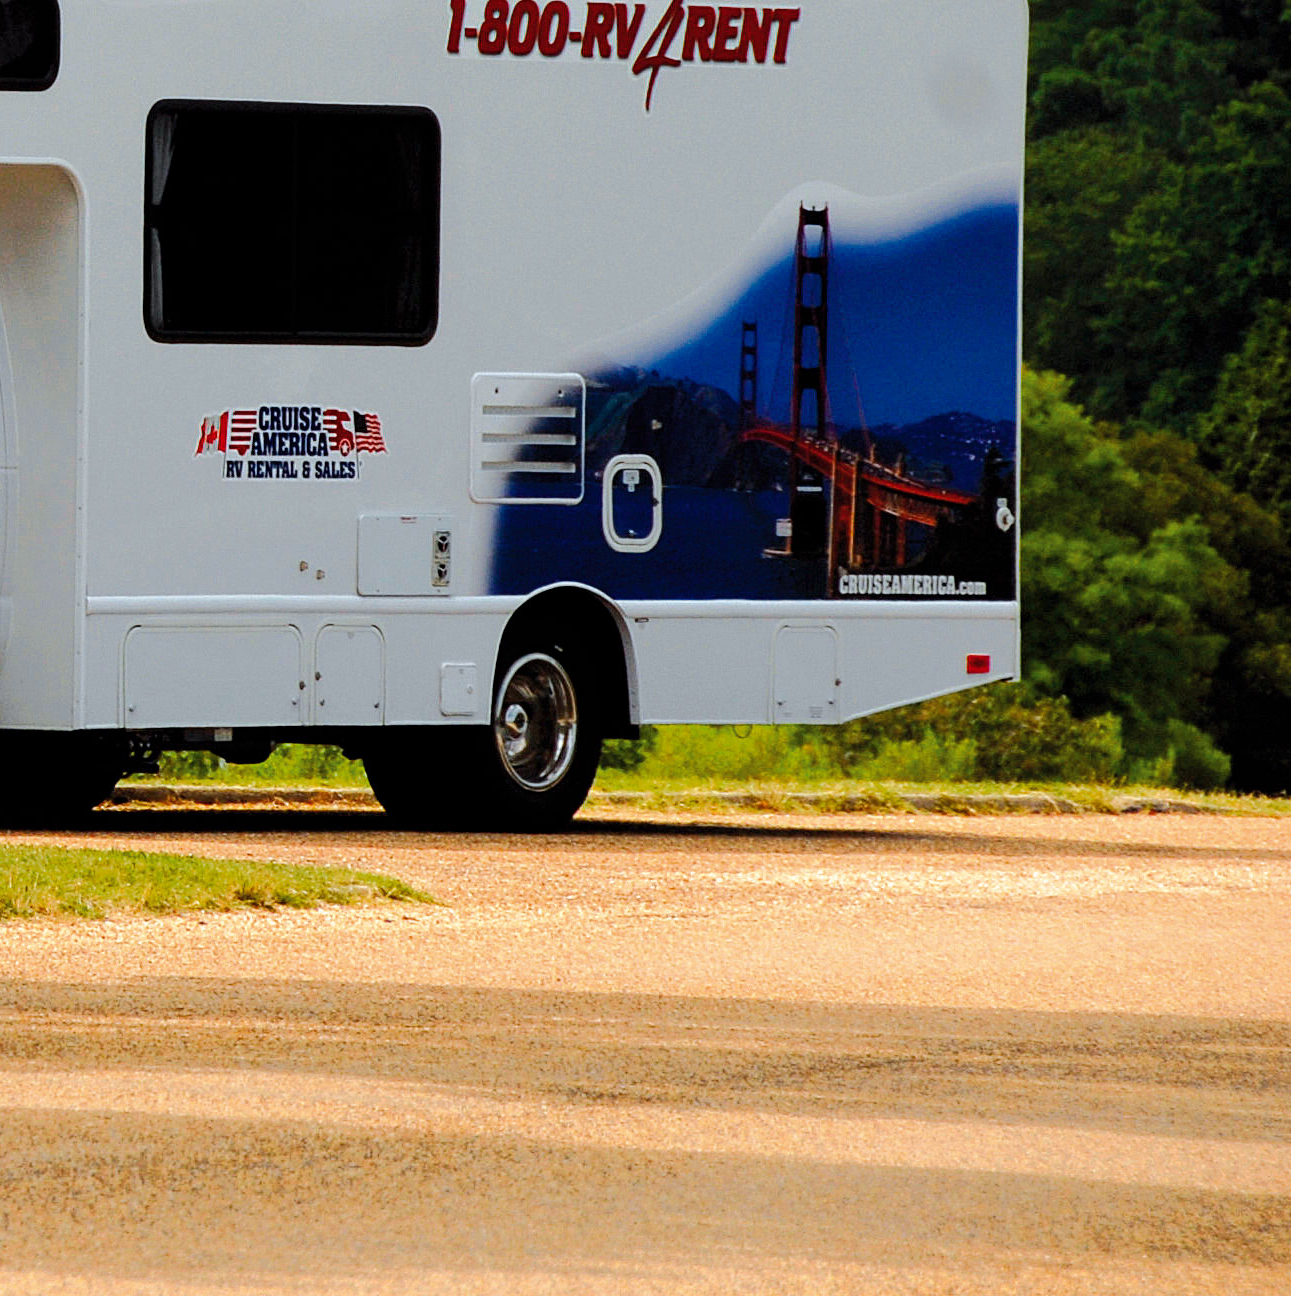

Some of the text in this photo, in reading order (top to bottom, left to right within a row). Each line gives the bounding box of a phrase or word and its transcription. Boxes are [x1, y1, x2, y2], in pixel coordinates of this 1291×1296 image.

[258, 406, 322, 431] CRUISE
[250, 432, 329, 457] AMERICA
[226, 460, 356, 479] RV RENTAL & SALES
[838, 574, 987, 596] CRUISEAMERICA.com
